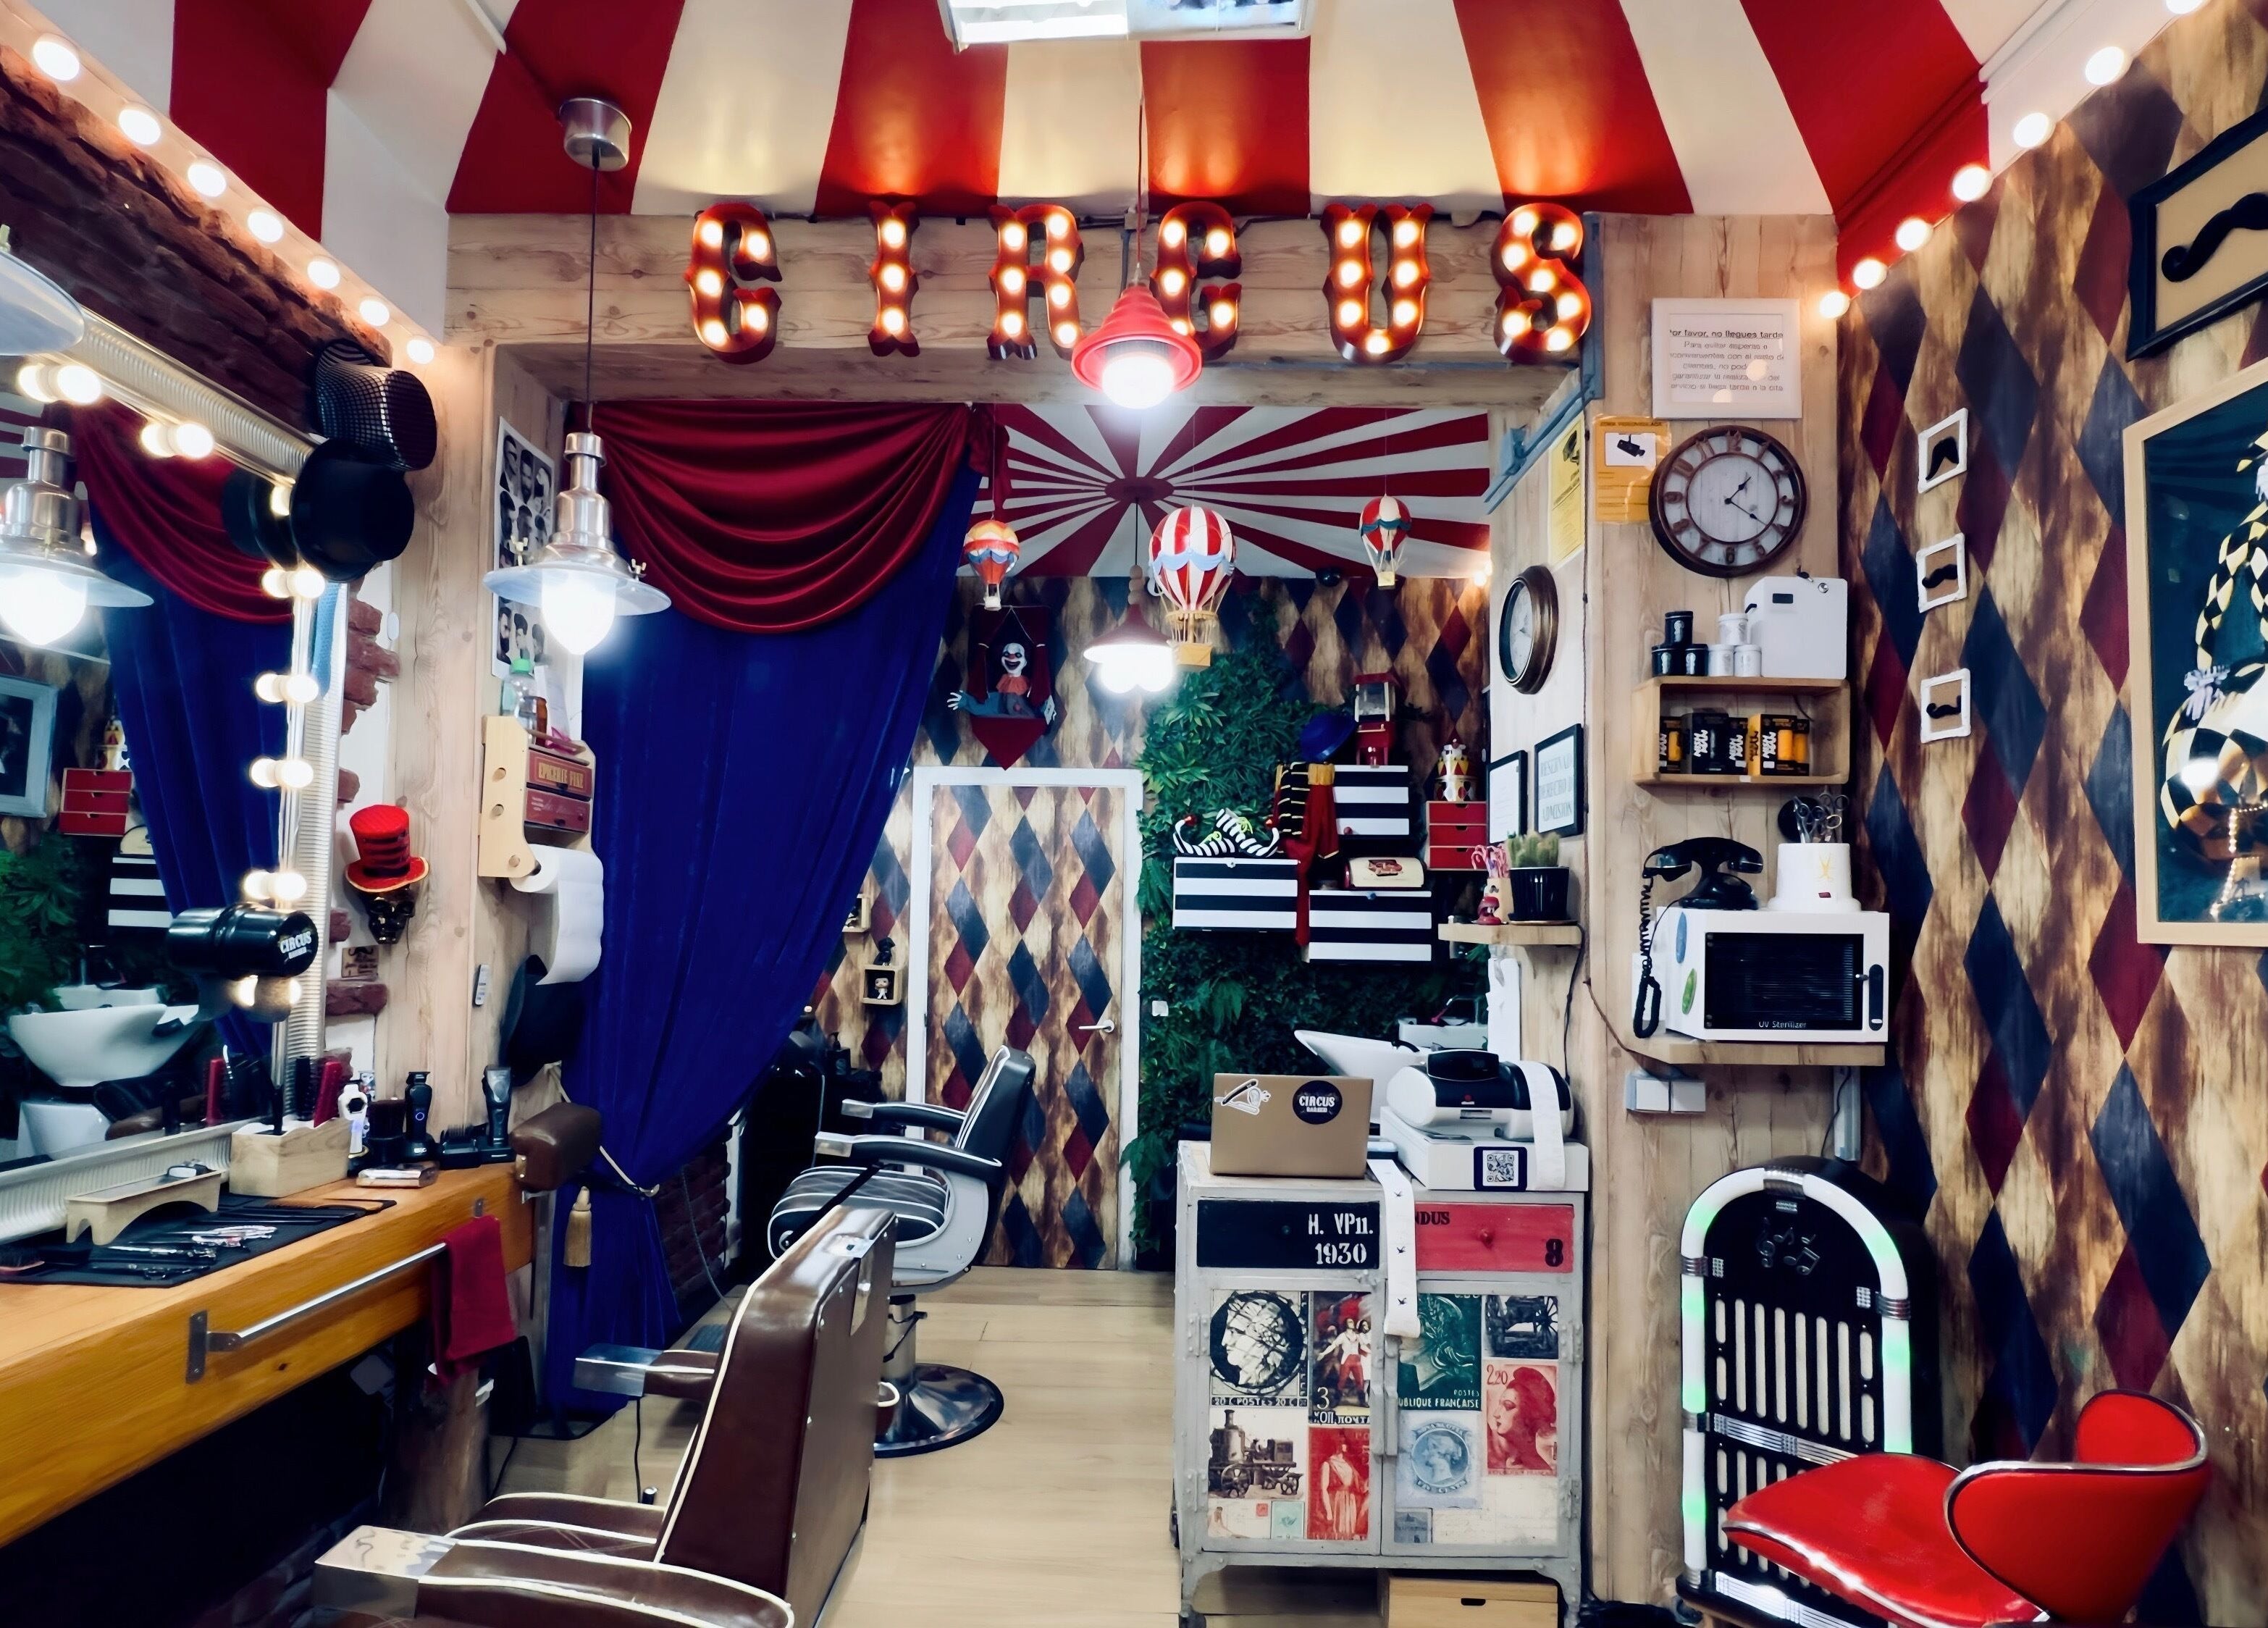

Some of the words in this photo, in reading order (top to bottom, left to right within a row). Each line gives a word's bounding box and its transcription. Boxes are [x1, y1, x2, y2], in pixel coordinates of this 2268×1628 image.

[686, 201, 1592, 365] CIRCUS
[1298, 1095, 1335, 1107] CIRCUS
[1308, 1213, 1324, 1235] H.
[1314, 1243, 1367, 1264] 1930
[1545, 1238, 1564, 1267] 8
[1316, 1386, 1330, 1409] 3
